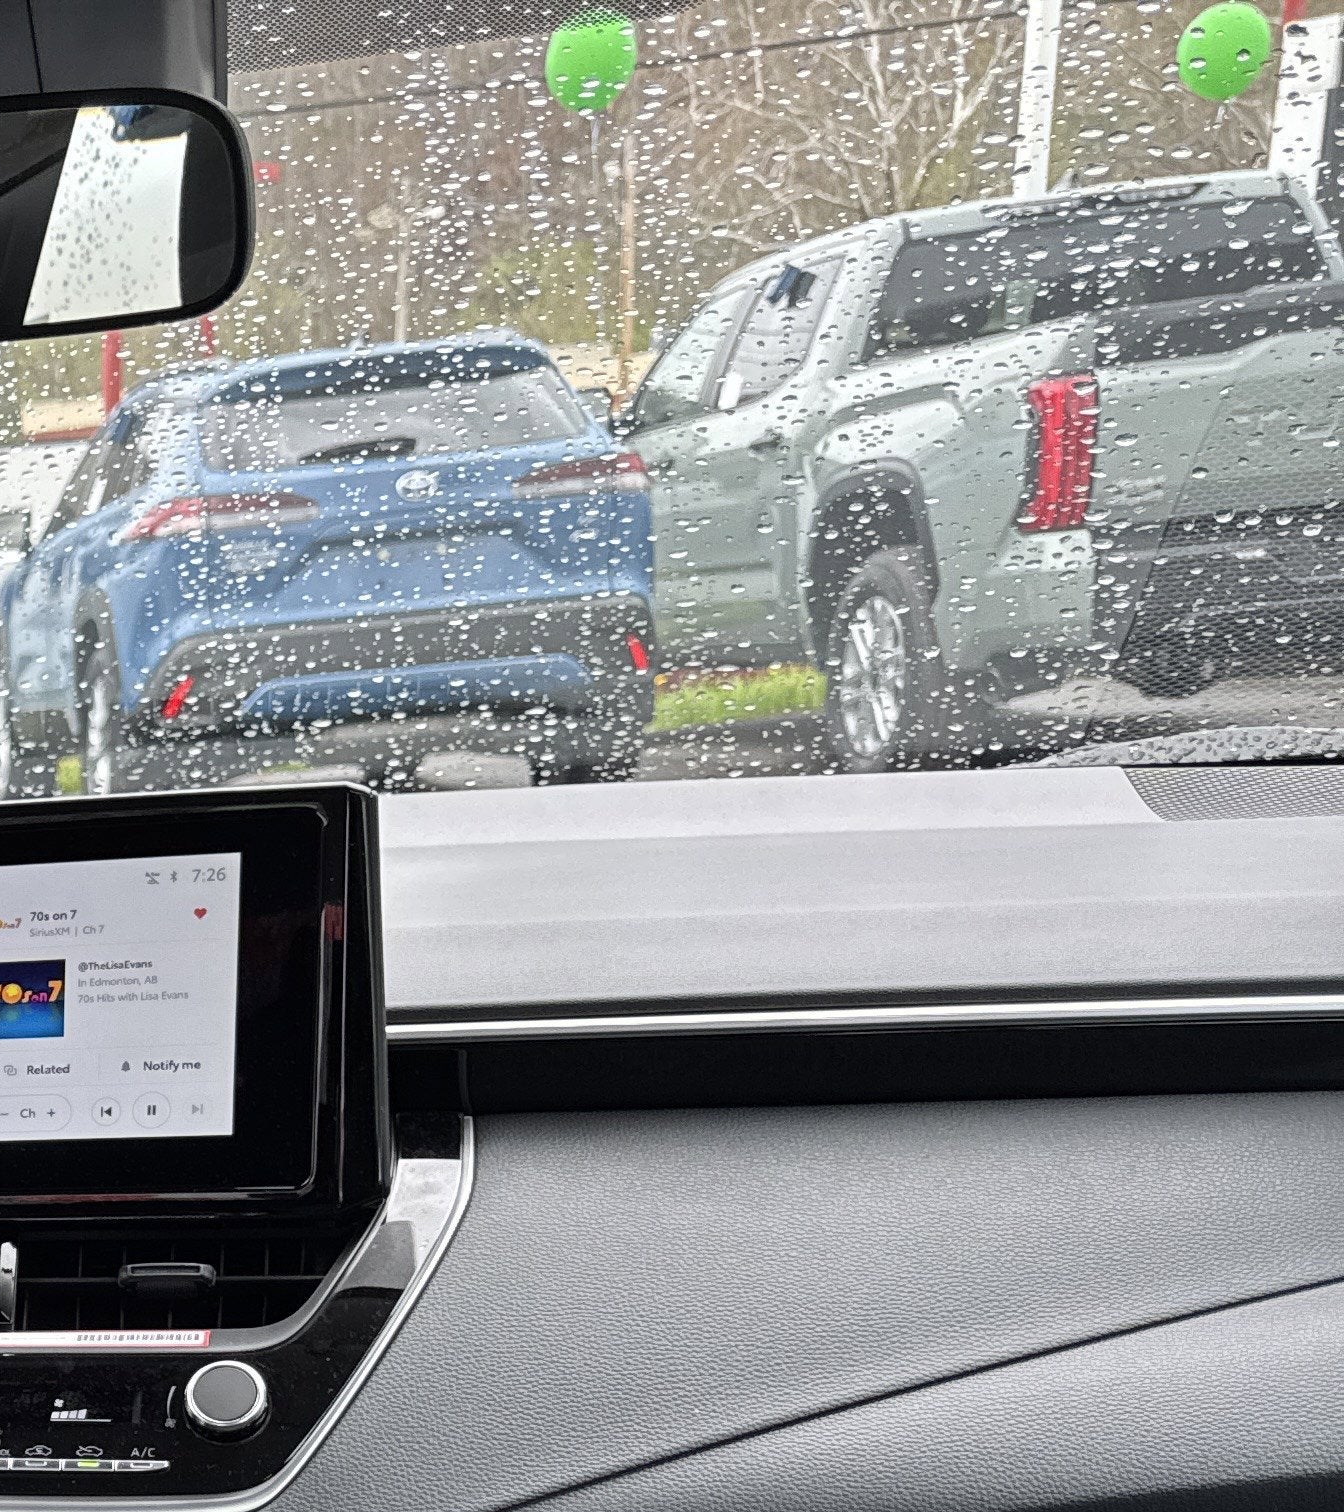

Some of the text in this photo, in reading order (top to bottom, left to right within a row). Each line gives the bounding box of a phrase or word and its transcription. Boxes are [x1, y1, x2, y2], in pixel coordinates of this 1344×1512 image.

[192, 867, 226, 883] 7:26
[29, 909, 77, 922] 70s on 7
[29, 924, 105, 938] SiriusXM Ch 7
[78, 959, 153, 972] @TheLisaEvans
[78, 975, 158, 988] In Edmonton, AB
[78, 990, 189, 1004] 70s Hits with Lisa Evans
[27, 1064, 70, 1076] Related
[143, 1060, 201, 1074] Notify me
[20, 1108, 36, 1119] Ch
[131, 1447, 156, 1457] A/C
